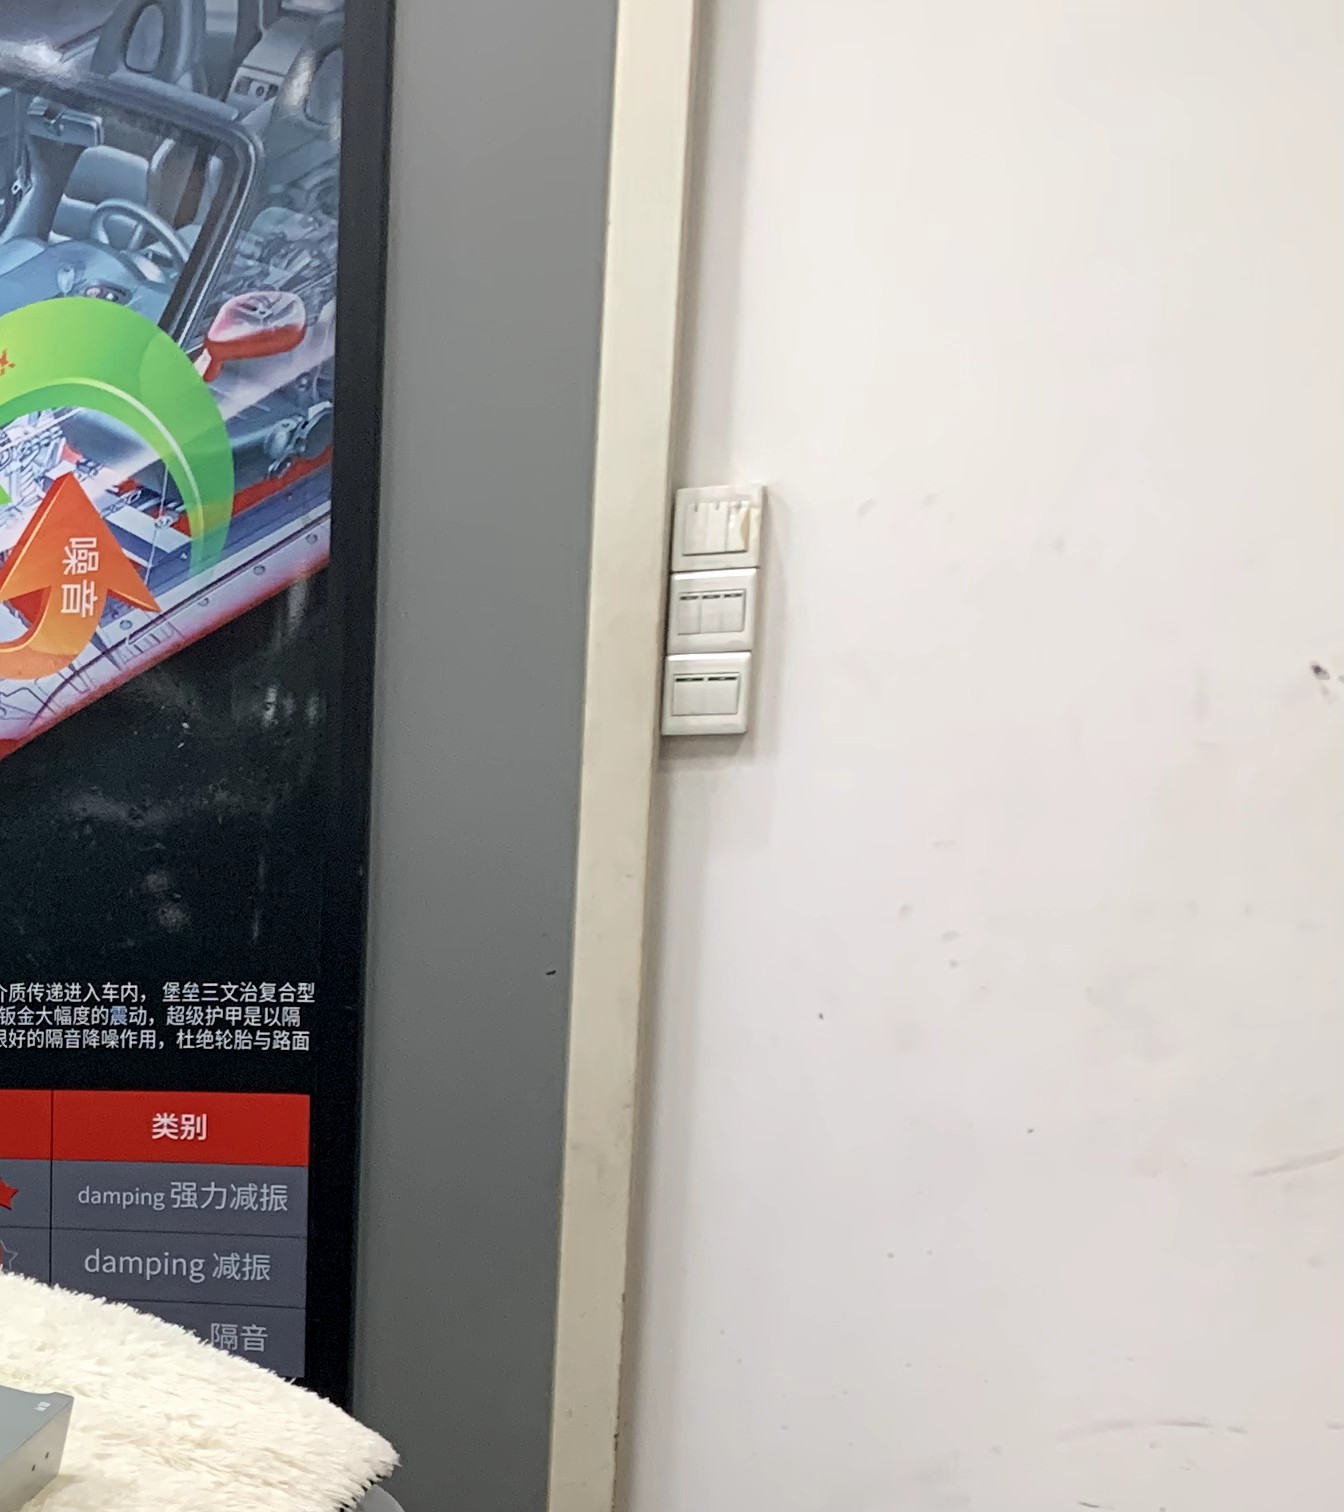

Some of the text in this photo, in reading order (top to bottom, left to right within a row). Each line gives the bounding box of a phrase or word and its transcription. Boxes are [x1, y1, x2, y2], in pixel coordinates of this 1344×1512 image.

[61, 537, 99, 618] 噪音
[151, 1112, 208, 1141] 类别
[77, 1181, 289, 1212] damping 强力减振
[84, 1249, 271, 1284] damping 减振
[211, 1322, 269, 1352] 隔音
